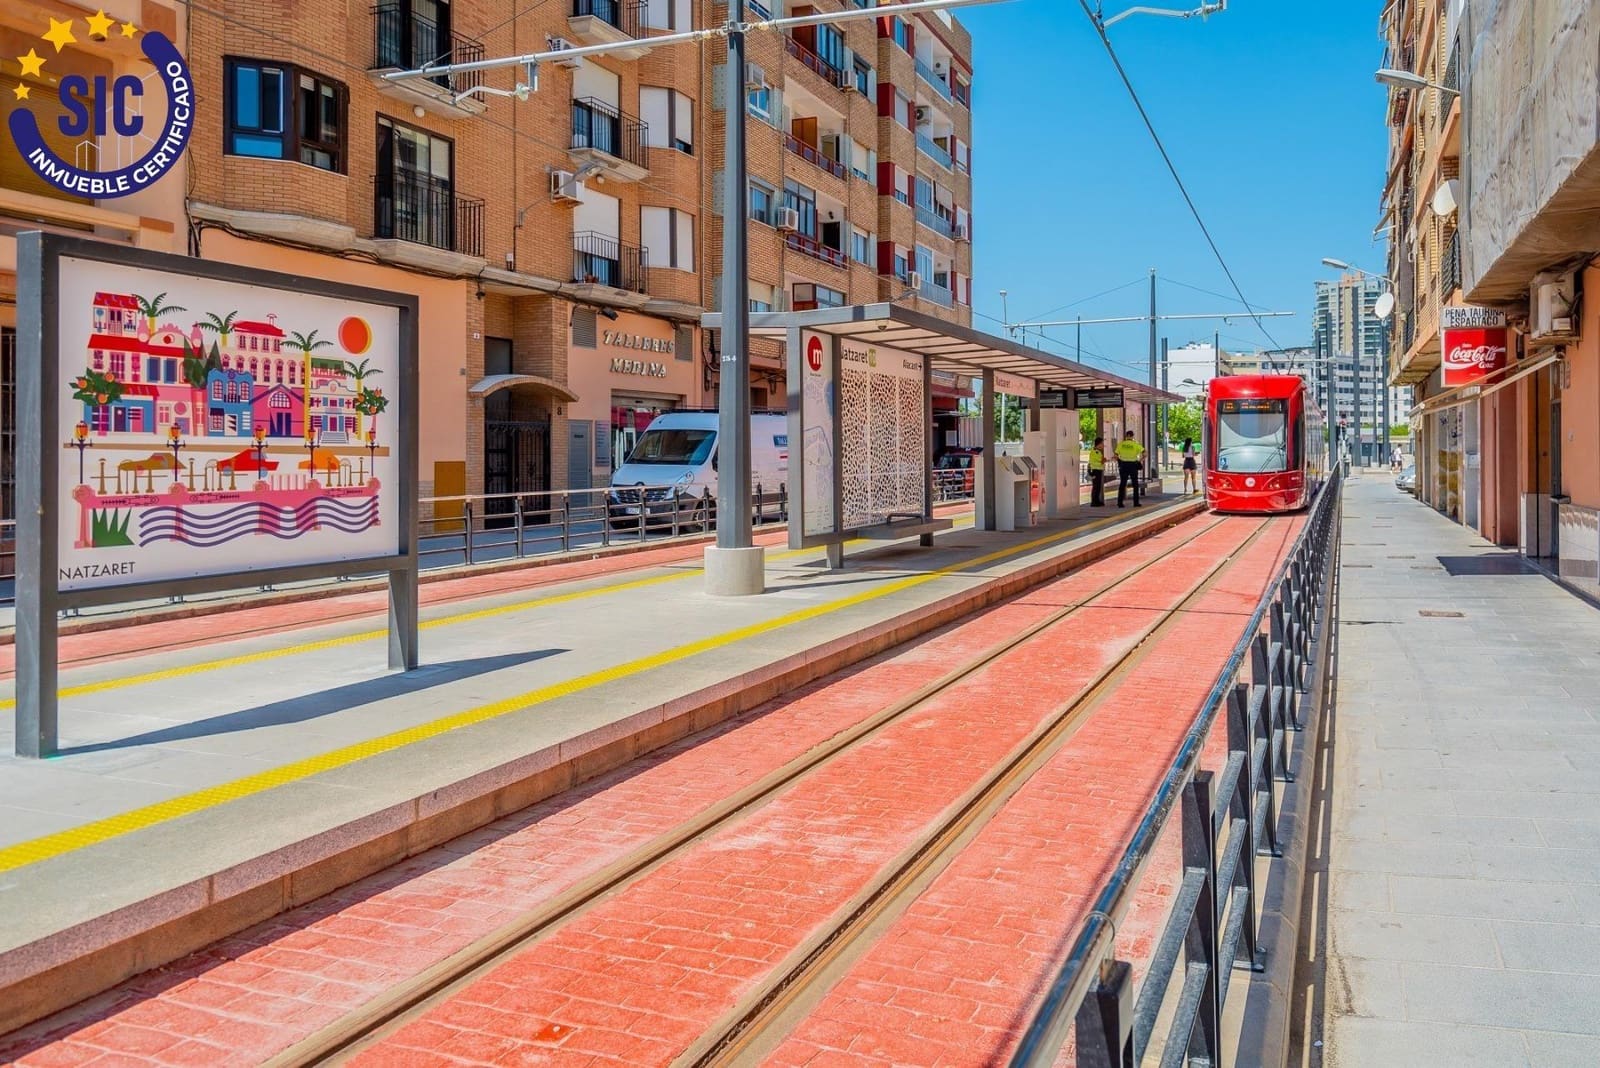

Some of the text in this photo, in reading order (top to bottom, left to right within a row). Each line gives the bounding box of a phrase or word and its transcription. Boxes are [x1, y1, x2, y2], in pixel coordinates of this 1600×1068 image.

[1450, 316, 1498, 328] ESPARTACO
[603, 329, 675, 354] TALLERES
[1449, 344, 1498, 363] Coca-Cola
[609, 358, 667, 379] MEDINA
[59, 561, 136, 581] NATZARET
